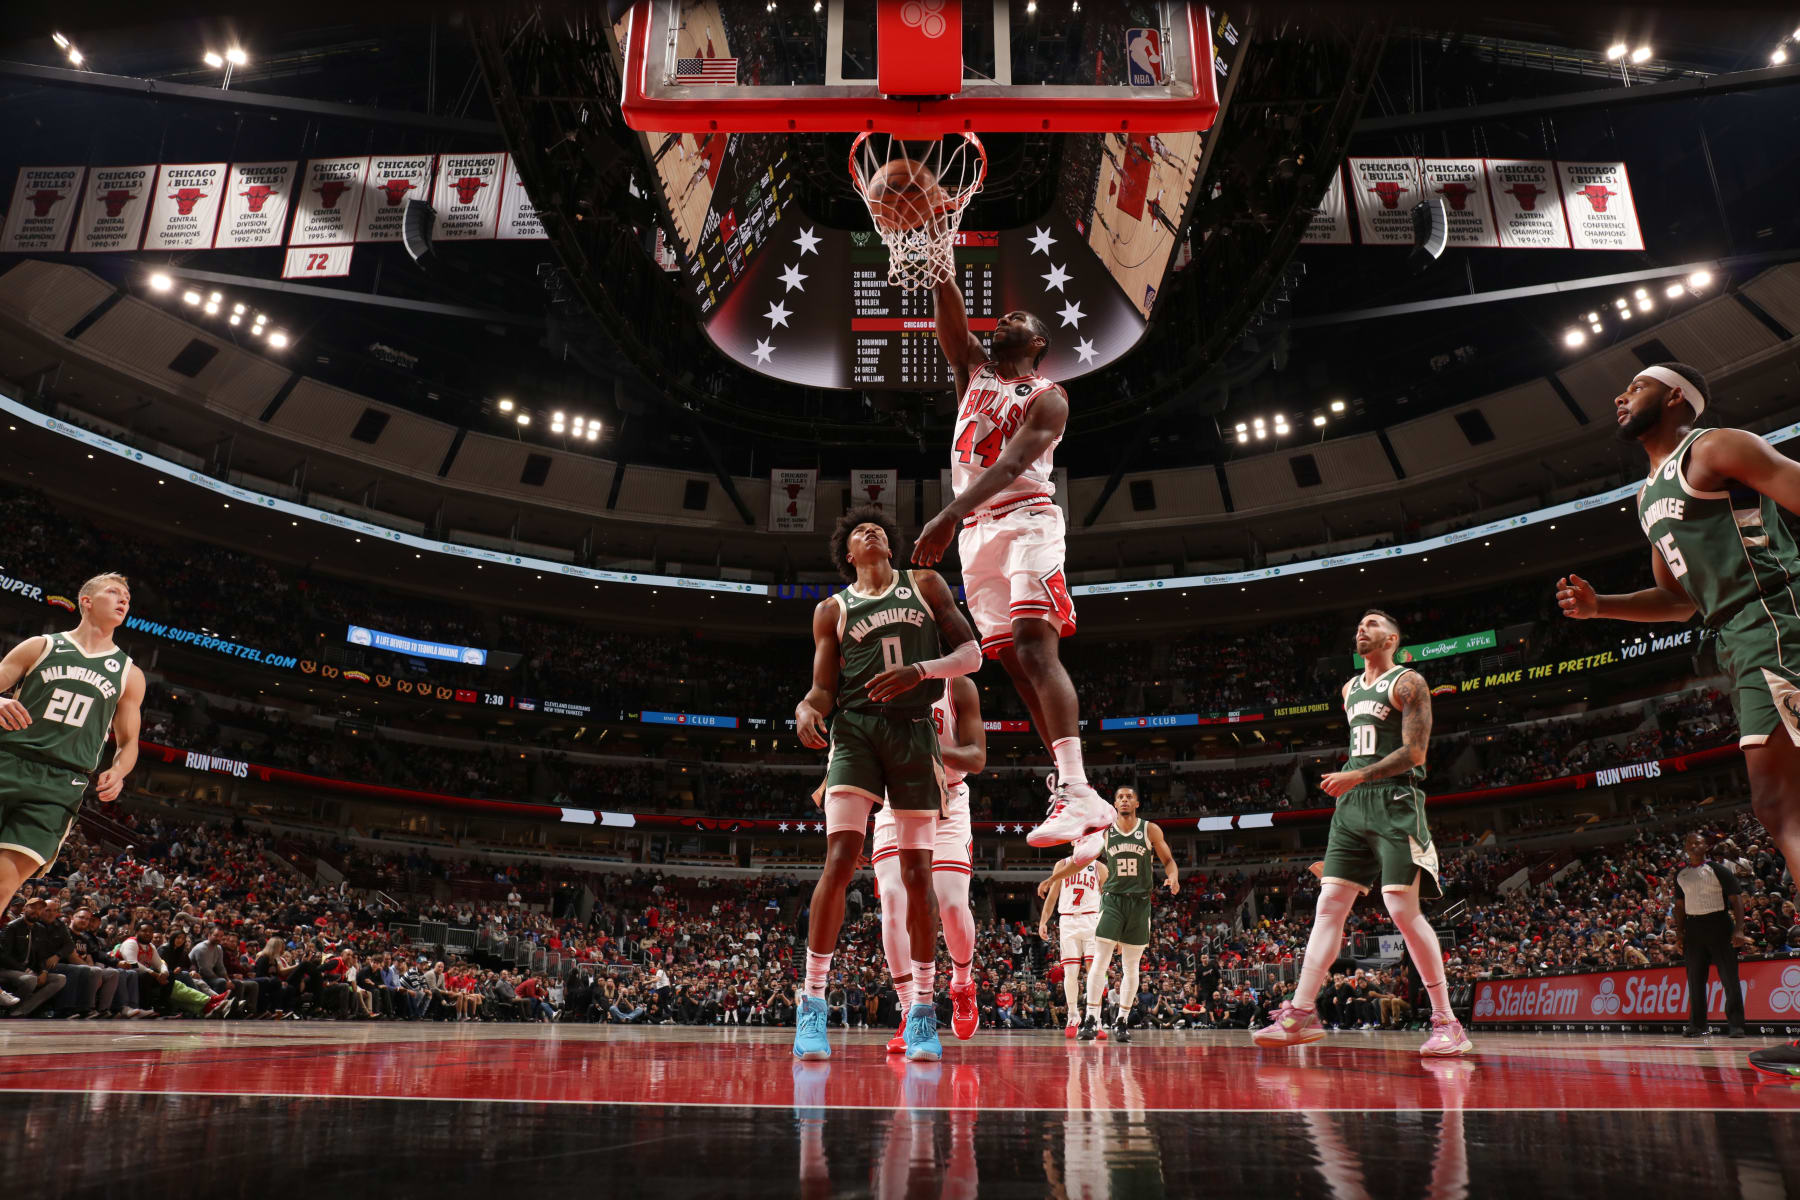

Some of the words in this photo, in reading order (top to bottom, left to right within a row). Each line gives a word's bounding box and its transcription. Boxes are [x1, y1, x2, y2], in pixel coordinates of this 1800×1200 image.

[1134, 74, 1150, 84] NBA
[313, 162, 360, 172] CHICAGO
[377, 161, 426, 169] CHICAGO
[448, 159, 496, 168] CHICAGO
[1360, 163, 1409, 172] CHICAGO
[240, 166, 287, 176] CHICAGO
[454, 168, 489, 176] BULLS
[1427, 164, 1476, 173] CHICAGO
[1496, 166, 1545, 174] CHICAGO
[1568, 167, 1617, 175] CHICAGO
[27, 171, 75, 180] CHICAGO
[98, 171, 146, 180] CHICAGO
[168, 170, 217, 178] CHICAGO
[320, 172, 352, 181] BULLS
[383, 170, 418, 178] BULLS
[1369, 173, 1404, 181] BULLS
[1437, 174, 1471, 182] BULLS
[104, 180, 137, 189] BULLS
[174, 179, 209, 187] BULLS
[245, 176, 279, 185] BULLS
[1577, 176, 1612, 184] BULLS
[32, 181, 66, 189] BULLS
[313, 208, 341, 216] CENTRAL
[311, 216, 341, 224] DIVISION
[230, 228, 271, 236] CHAMPIONS
[304, 224, 344, 232] CHAMPIONS
[306, 253, 329, 271] 72
[904, 321, 928, 329] CHICAGO
[960, 389, 1022, 439] BULLS
[955, 421, 1004, 468] 44
[849, 608, 926, 643] MILWAUKEE
[126, 616, 297, 669] WWW.SUPERPRETZEL.COM
[380, 636, 389, 646] LIFE
[418, 644, 438, 655] TEQUILA
[1466, 638, 1491, 648] APPLE
[882, 637, 904, 672] 0
[1461, 680, 1480, 693] WE
[1485, 670, 1522, 688] MAKE
[1528, 664, 1553, 680] THE
[1558, 651, 1619, 675] PRETZEL.
[1622, 643, 1647, 660] YOU
[1651, 630, 1692, 652] MAKE
[40, 665, 117, 700] MILWAUKEE
[485, 693, 504, 706] 7:30
[43, 688, 95, 728] 20
[544, 701, 568, 709] CLEVELAND
[568, 704, 591, 712] GUARDIANS
[1274, 708, 1288, 717] FAST
[1289, 705, 1308, 715] BREAK
[1308, 703, 1330, 712] POINTS
[692, 716, 715, 725] CLUB
[1153, 717, 1177, 726] CLUB
[984, 721, 1002, 731] ICAGO
[1351, 725, 1376, 757] 30
[185, 752, 211, 771] RUN
[211, 756, 234, 772] WITH
[233, 760, 249, 778] US
[1596, 768, 1621, 787] RUN
[1620, 764, 1644, 779] WITH
[1643, 760, 1661, 779] US
[1108, 844, 1147, 857] MILWAUKEE
[1117, 858, 1138, 877] 28
[1065, 874, 1096, 890] BULLS
[1072, 888, 1085, 906] 7
